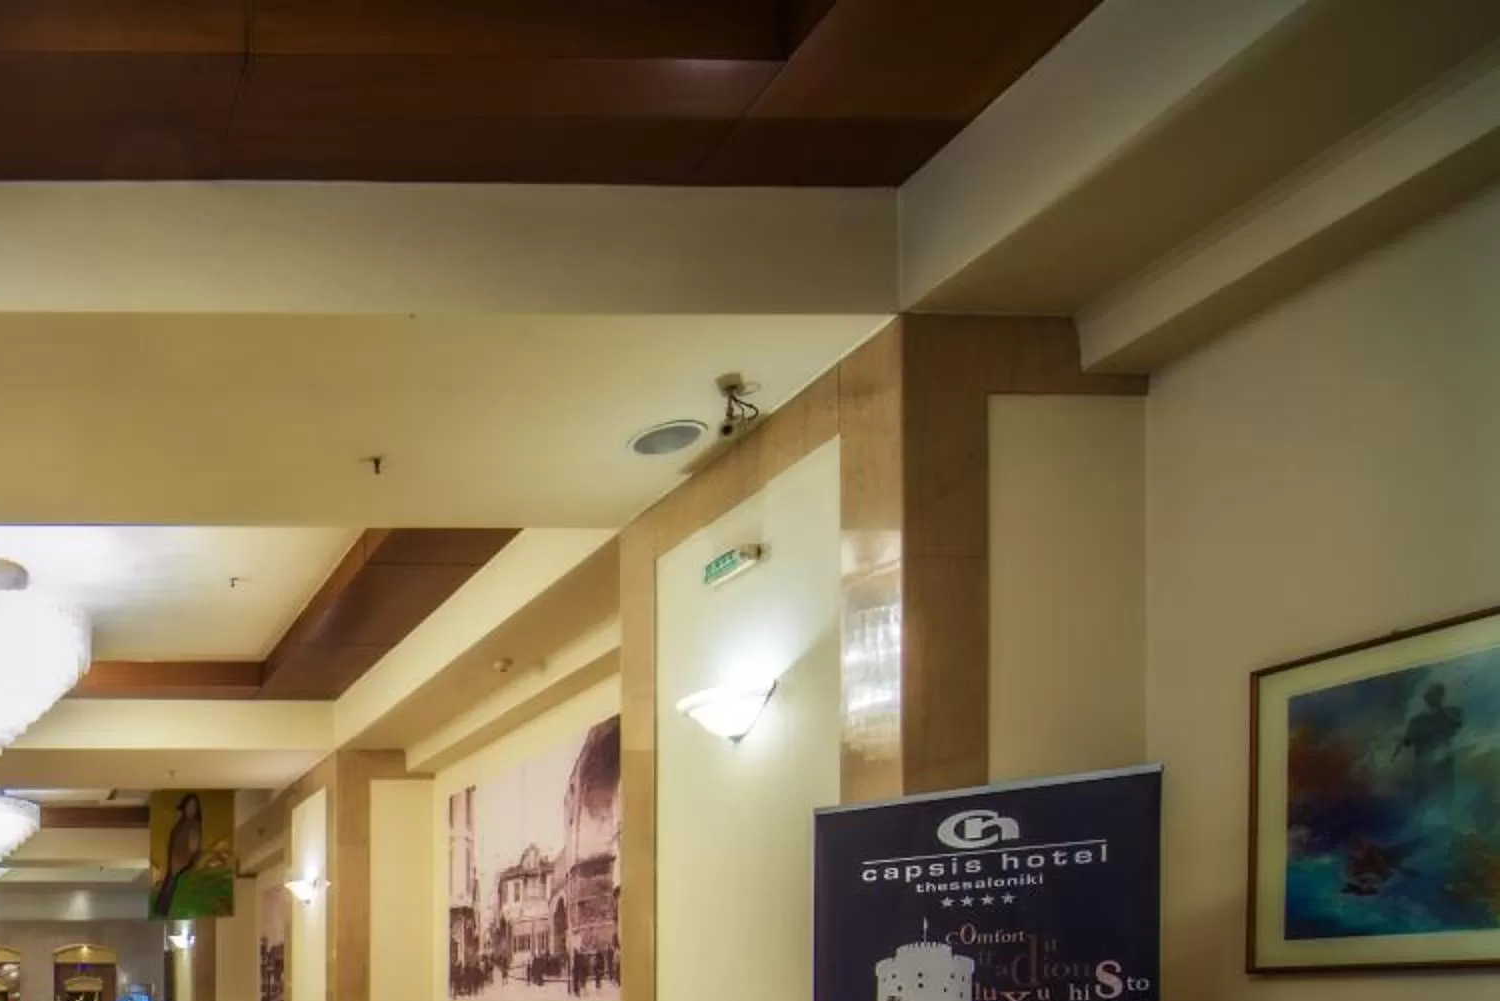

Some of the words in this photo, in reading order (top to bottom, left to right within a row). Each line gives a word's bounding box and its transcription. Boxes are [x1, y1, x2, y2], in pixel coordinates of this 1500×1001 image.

[861, 856, 982, 883] capsis
[1002, 844, 1108, 871] hotel
[915, 873, 1044, 893] thessaloniki
